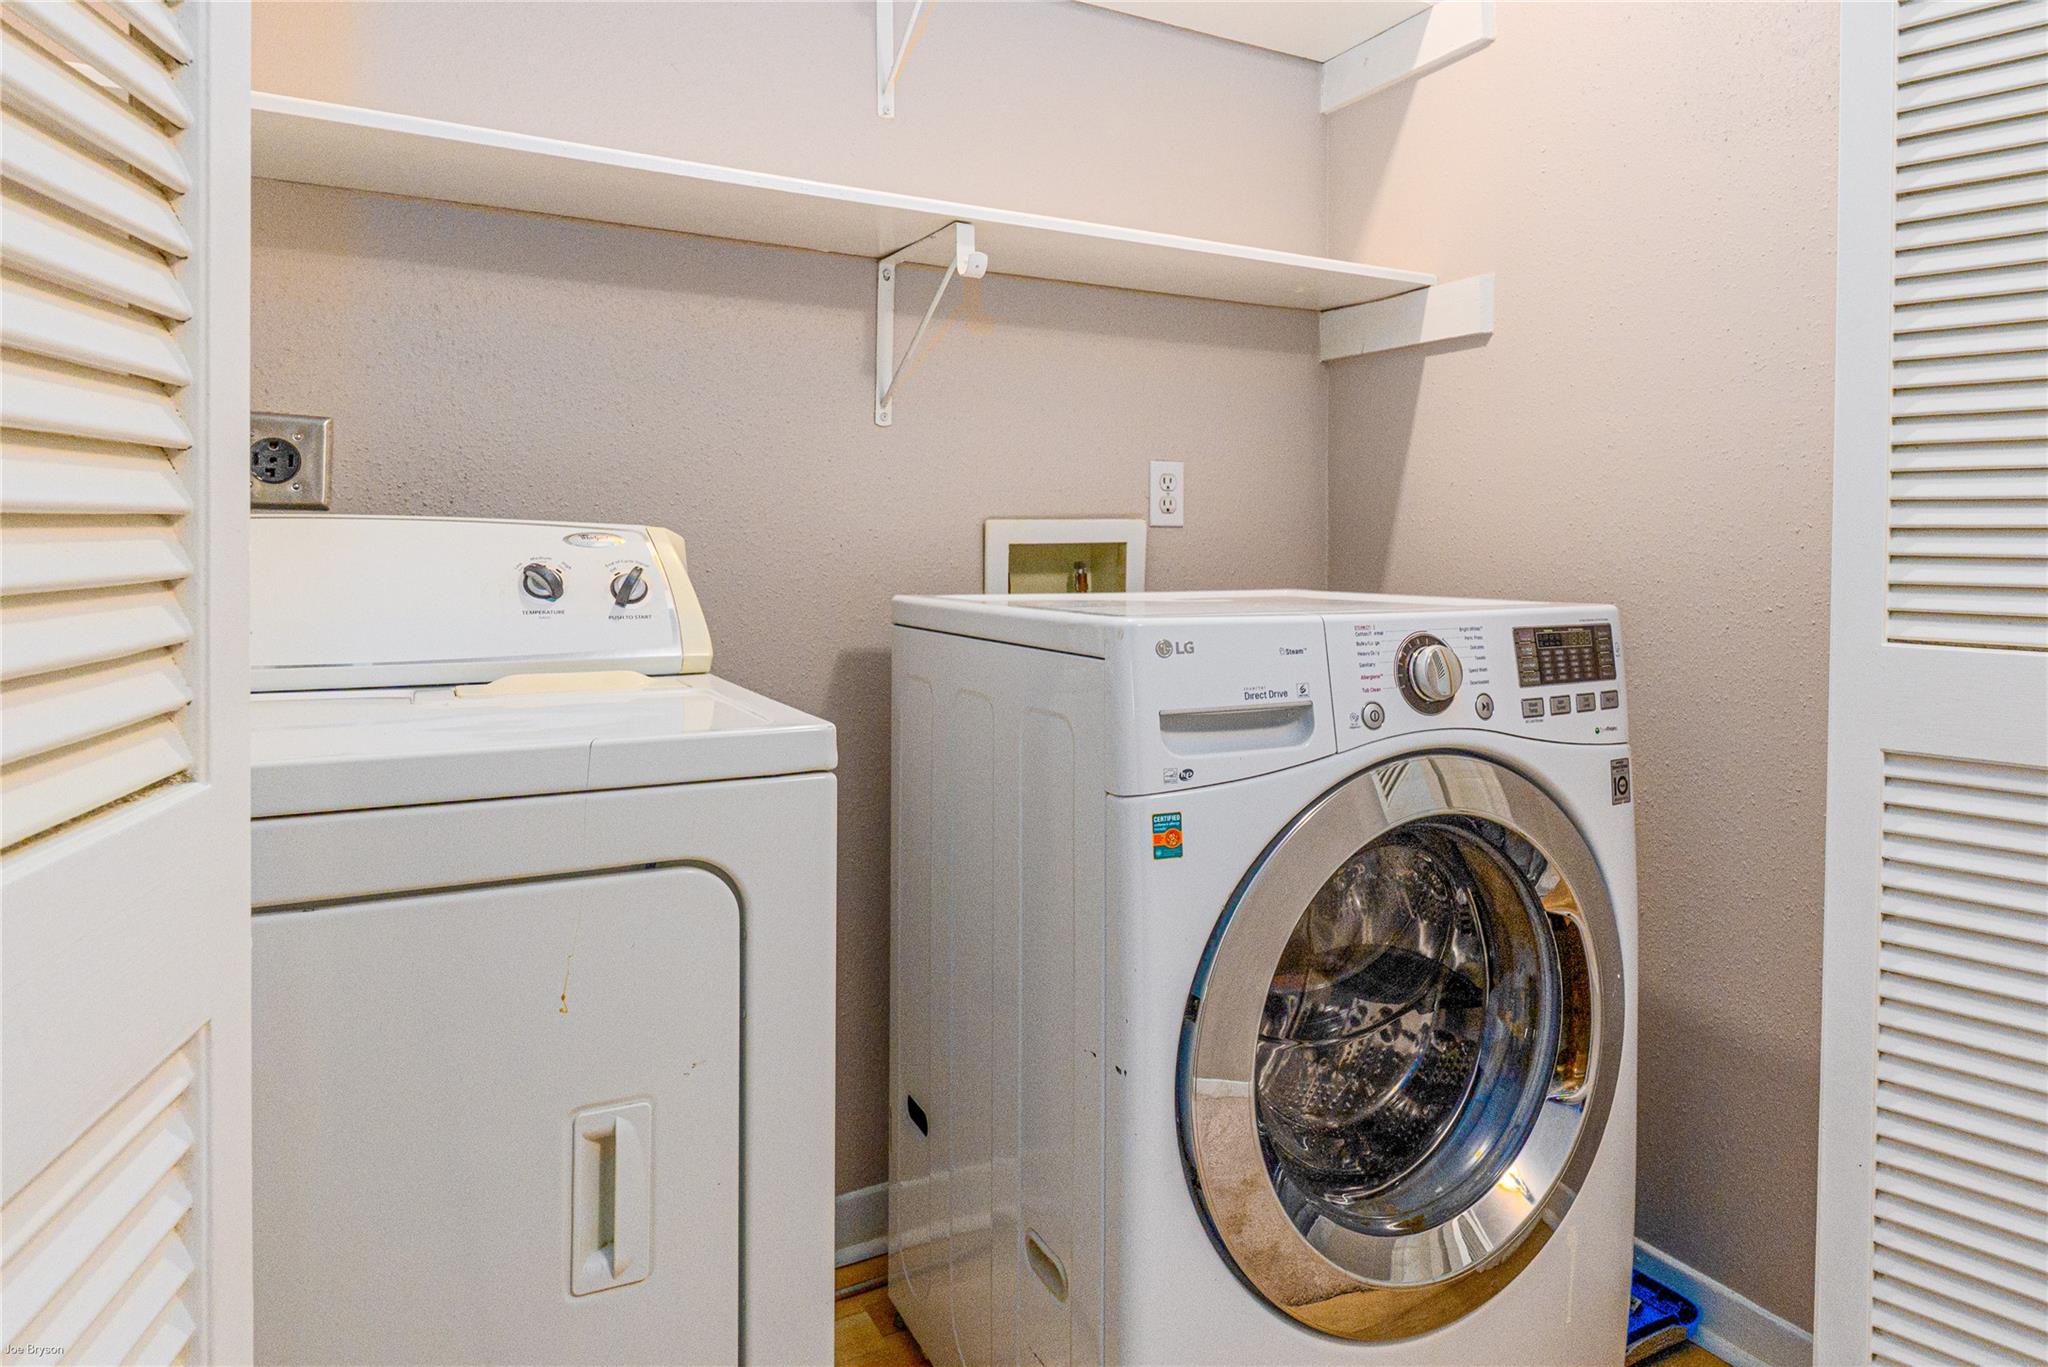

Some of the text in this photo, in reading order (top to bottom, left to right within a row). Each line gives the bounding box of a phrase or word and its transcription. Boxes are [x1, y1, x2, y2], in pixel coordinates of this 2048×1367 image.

[1176, 641, 1194, 655] LG
[1244, 690, 1288, 700] Direct Drive
[1153, 814, 1181, 823] CERTIFIED
